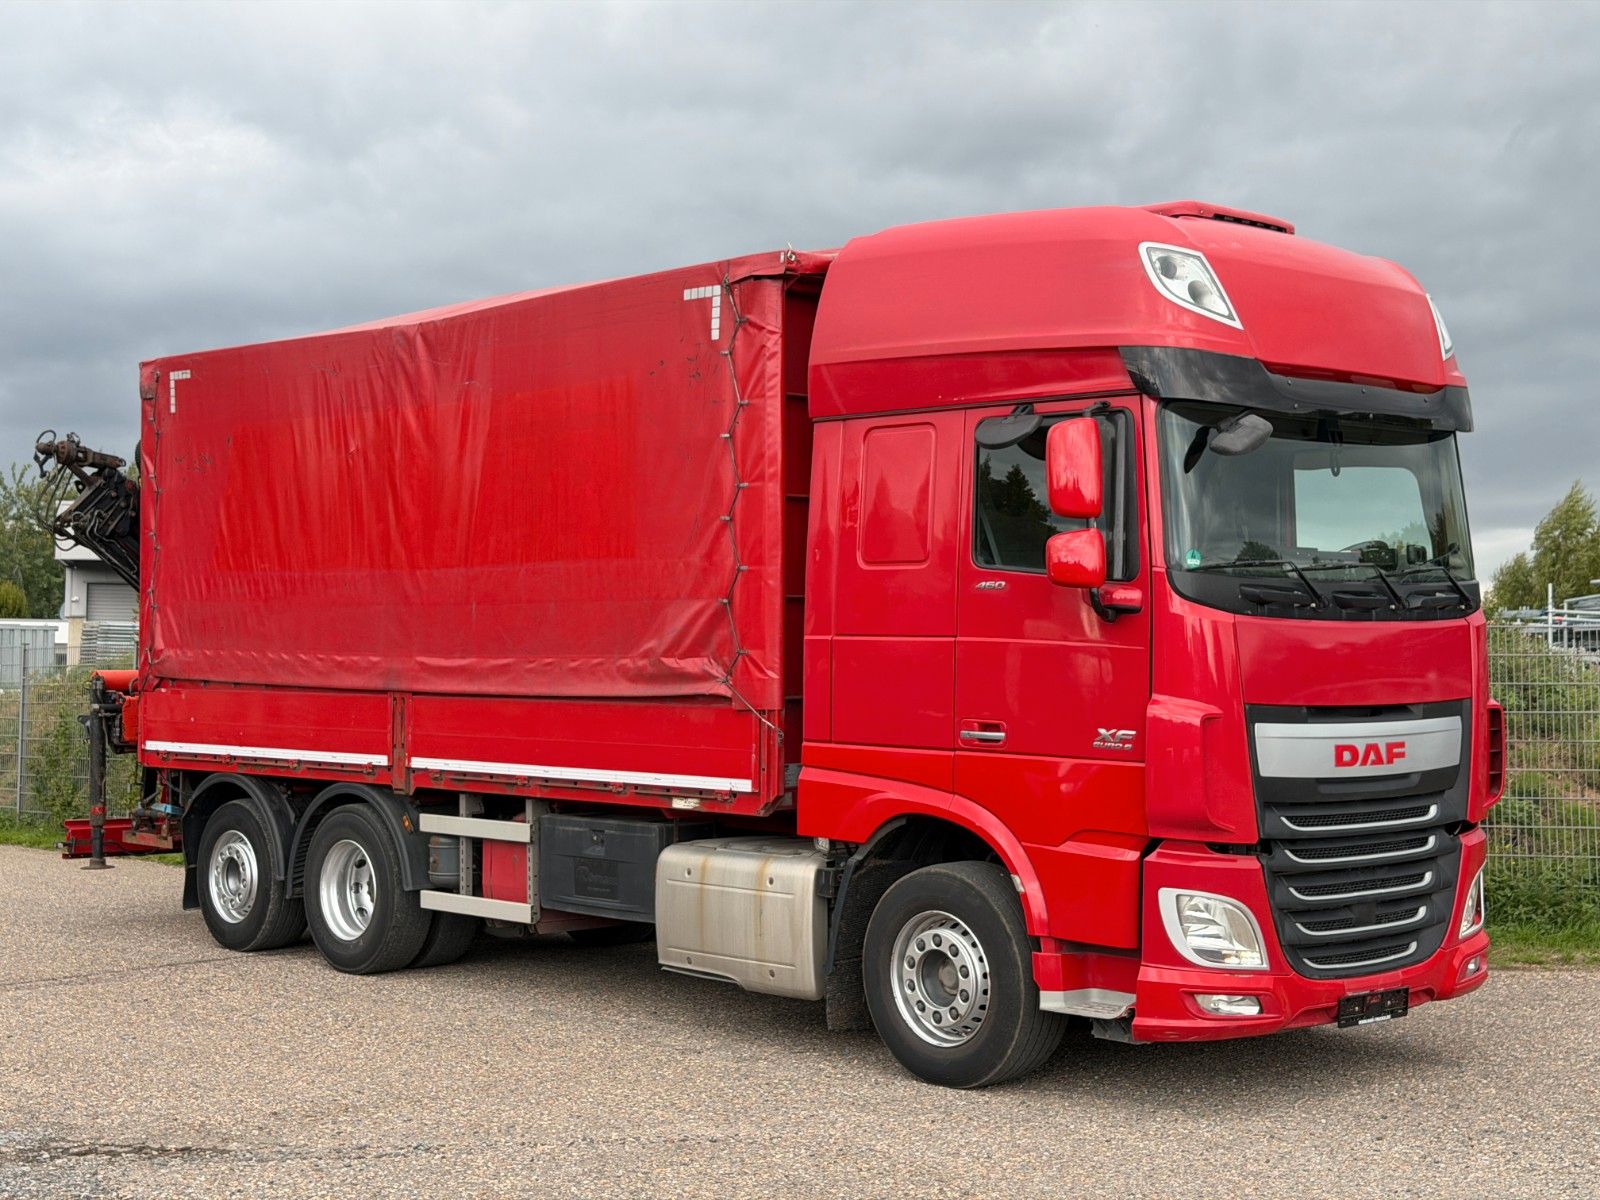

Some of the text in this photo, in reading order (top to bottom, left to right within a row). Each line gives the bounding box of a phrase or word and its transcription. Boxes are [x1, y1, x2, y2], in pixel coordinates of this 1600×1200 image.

[976, 581, 1006, 590] 460
[1094, 727, 1137, 742] XF
[1334, 741, 1406, 768] DAF
